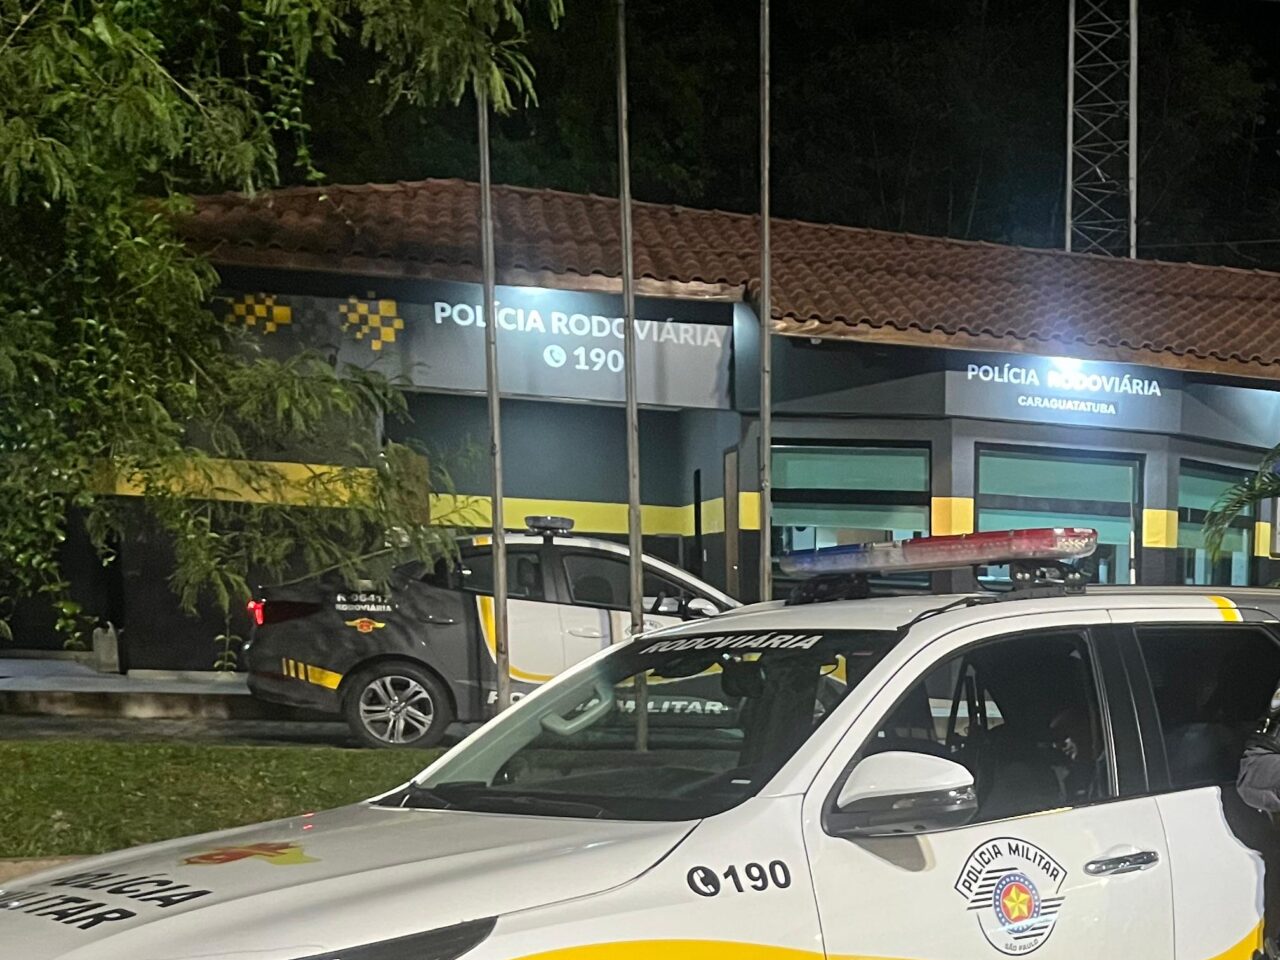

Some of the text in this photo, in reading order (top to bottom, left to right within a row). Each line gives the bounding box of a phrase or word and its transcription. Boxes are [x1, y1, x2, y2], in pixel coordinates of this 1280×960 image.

[434, 301, 722, 348] POLÍCIA RODOVIÁRIA
[572, 345, 625, 373] 190
[966, 364, 1162, 397] POLÍCIA RODOVIÁRIA
[1017, 396, 1116, 415] CARAGUATATUBA
[639, 632, 824, 654] RODOVIÁRIA
[722, 859, 792, 893] 190
[961, 841, 1060, 893] POLÍCIA MILITAR
